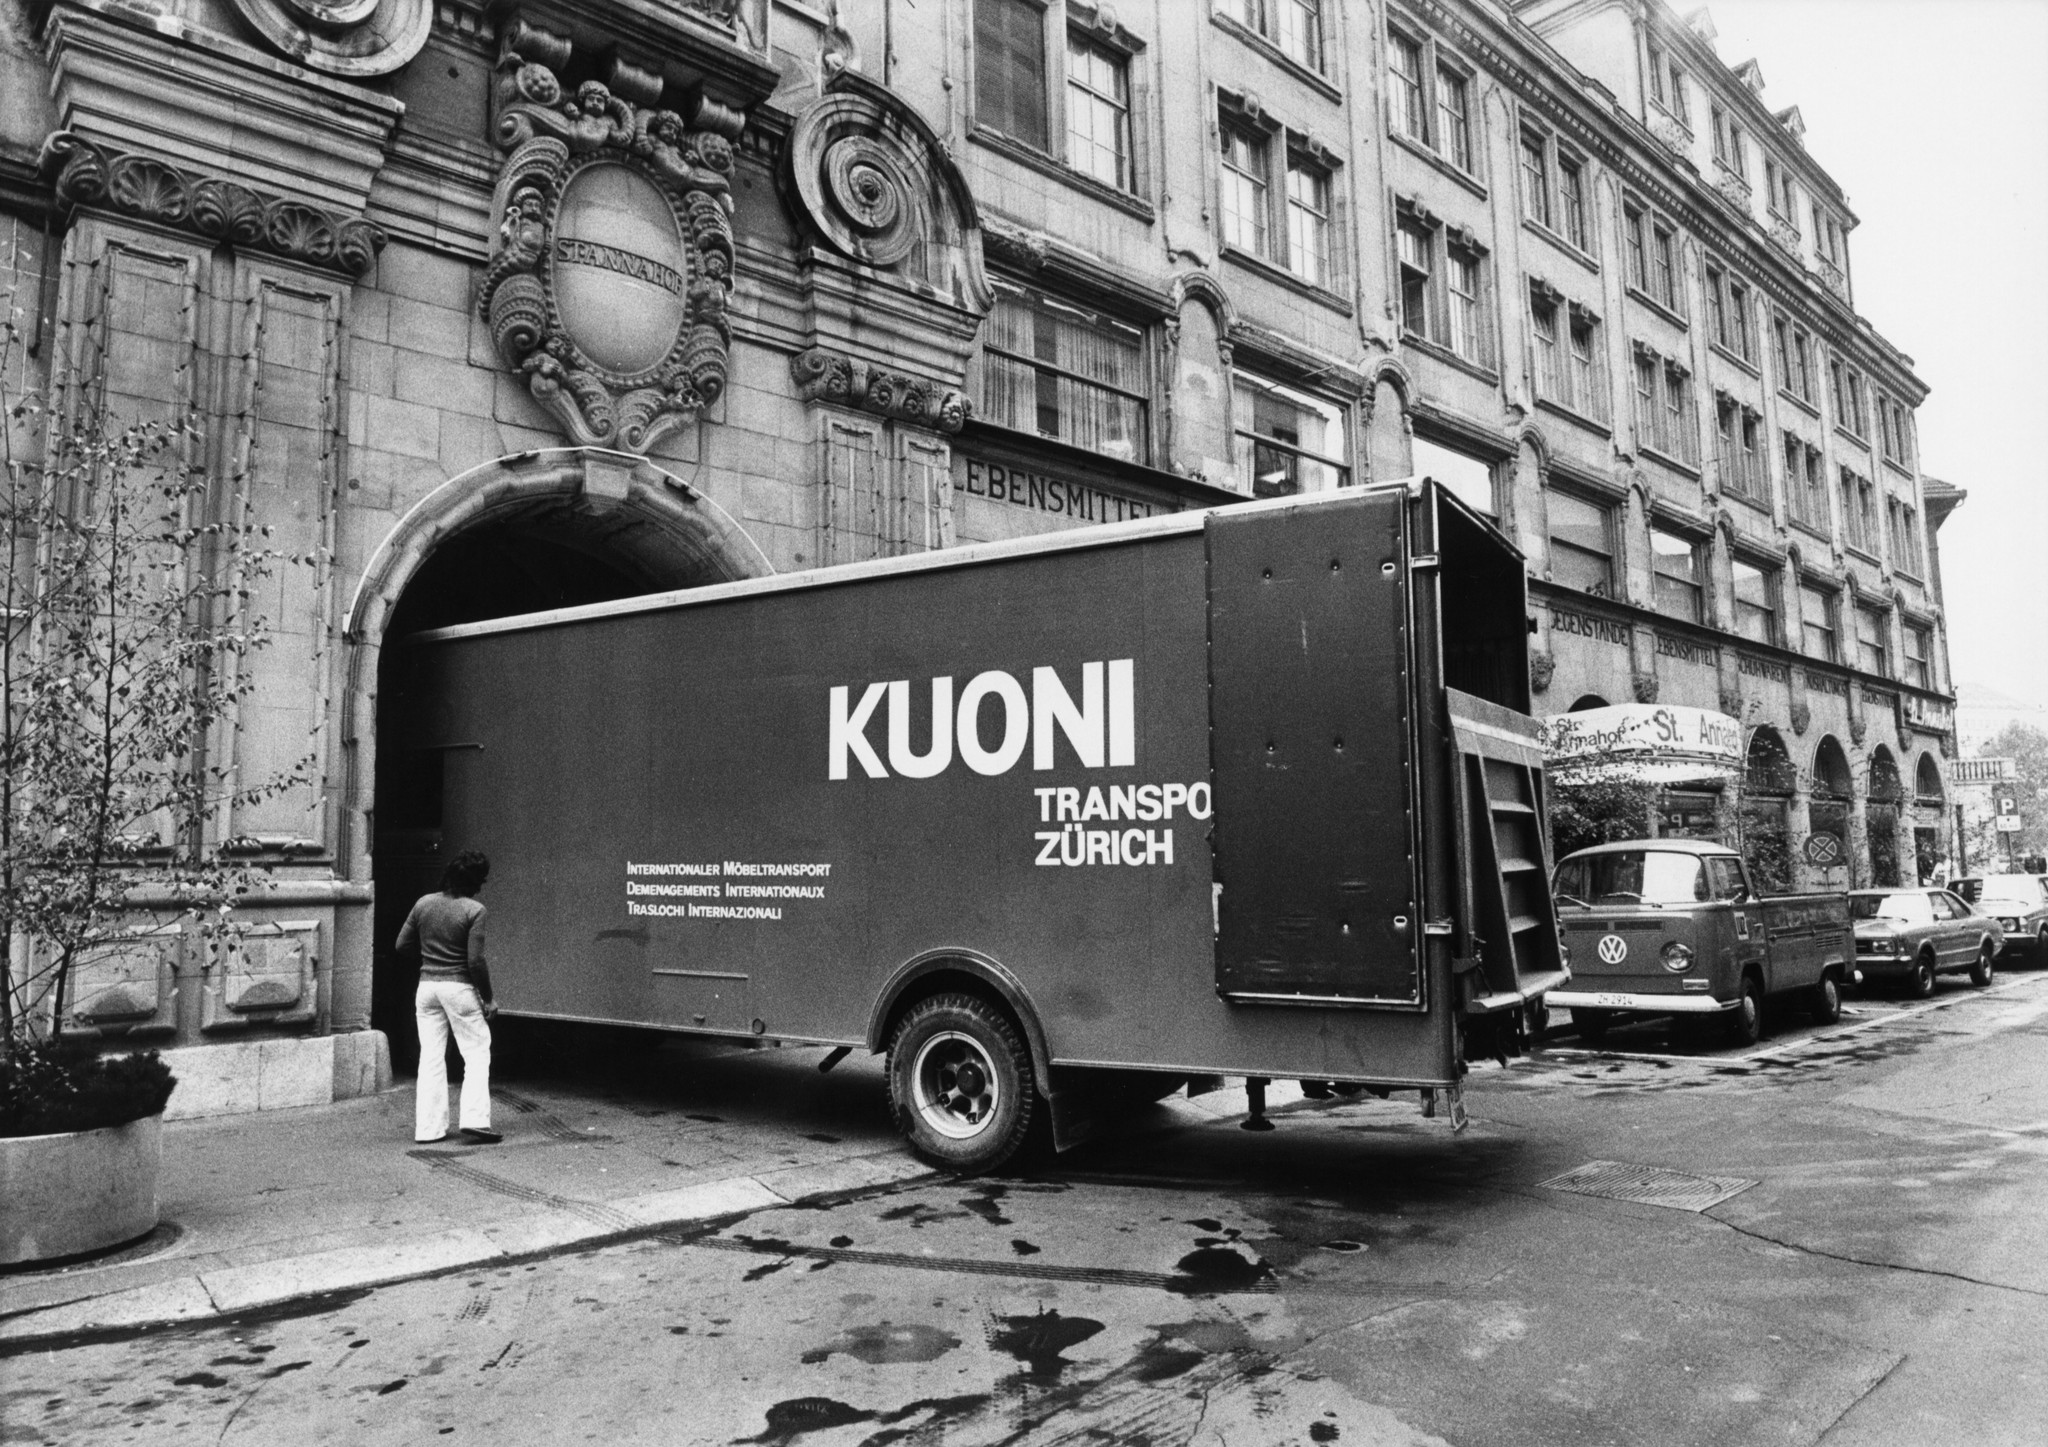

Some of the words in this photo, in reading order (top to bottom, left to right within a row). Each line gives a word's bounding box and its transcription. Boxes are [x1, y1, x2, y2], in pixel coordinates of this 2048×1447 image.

[1656, 635, 1716, 667] EBENSMITTEL
[829, 658, 1135, 780] KUONI
[1656, 709, 1684, 742] St.
[1034, 782, 1212, 822] TRANSPO
[2001, 799, 2014, 815] P
[1034, 823, 1174, 867] ZÜRICH
[627, 861, 720, 876] INTERNATIONALER
[723, 861, 831, 877] MÖBELTRANSPORT
[627, 881, 720, 897] DEMENAGEMENTS
[725, 882, 825, 898] INTERNATIONAUX
[627, 901, 685, 917] TRASLOCHI
[688, 903, 782, 920] INTERNAZIONALI
